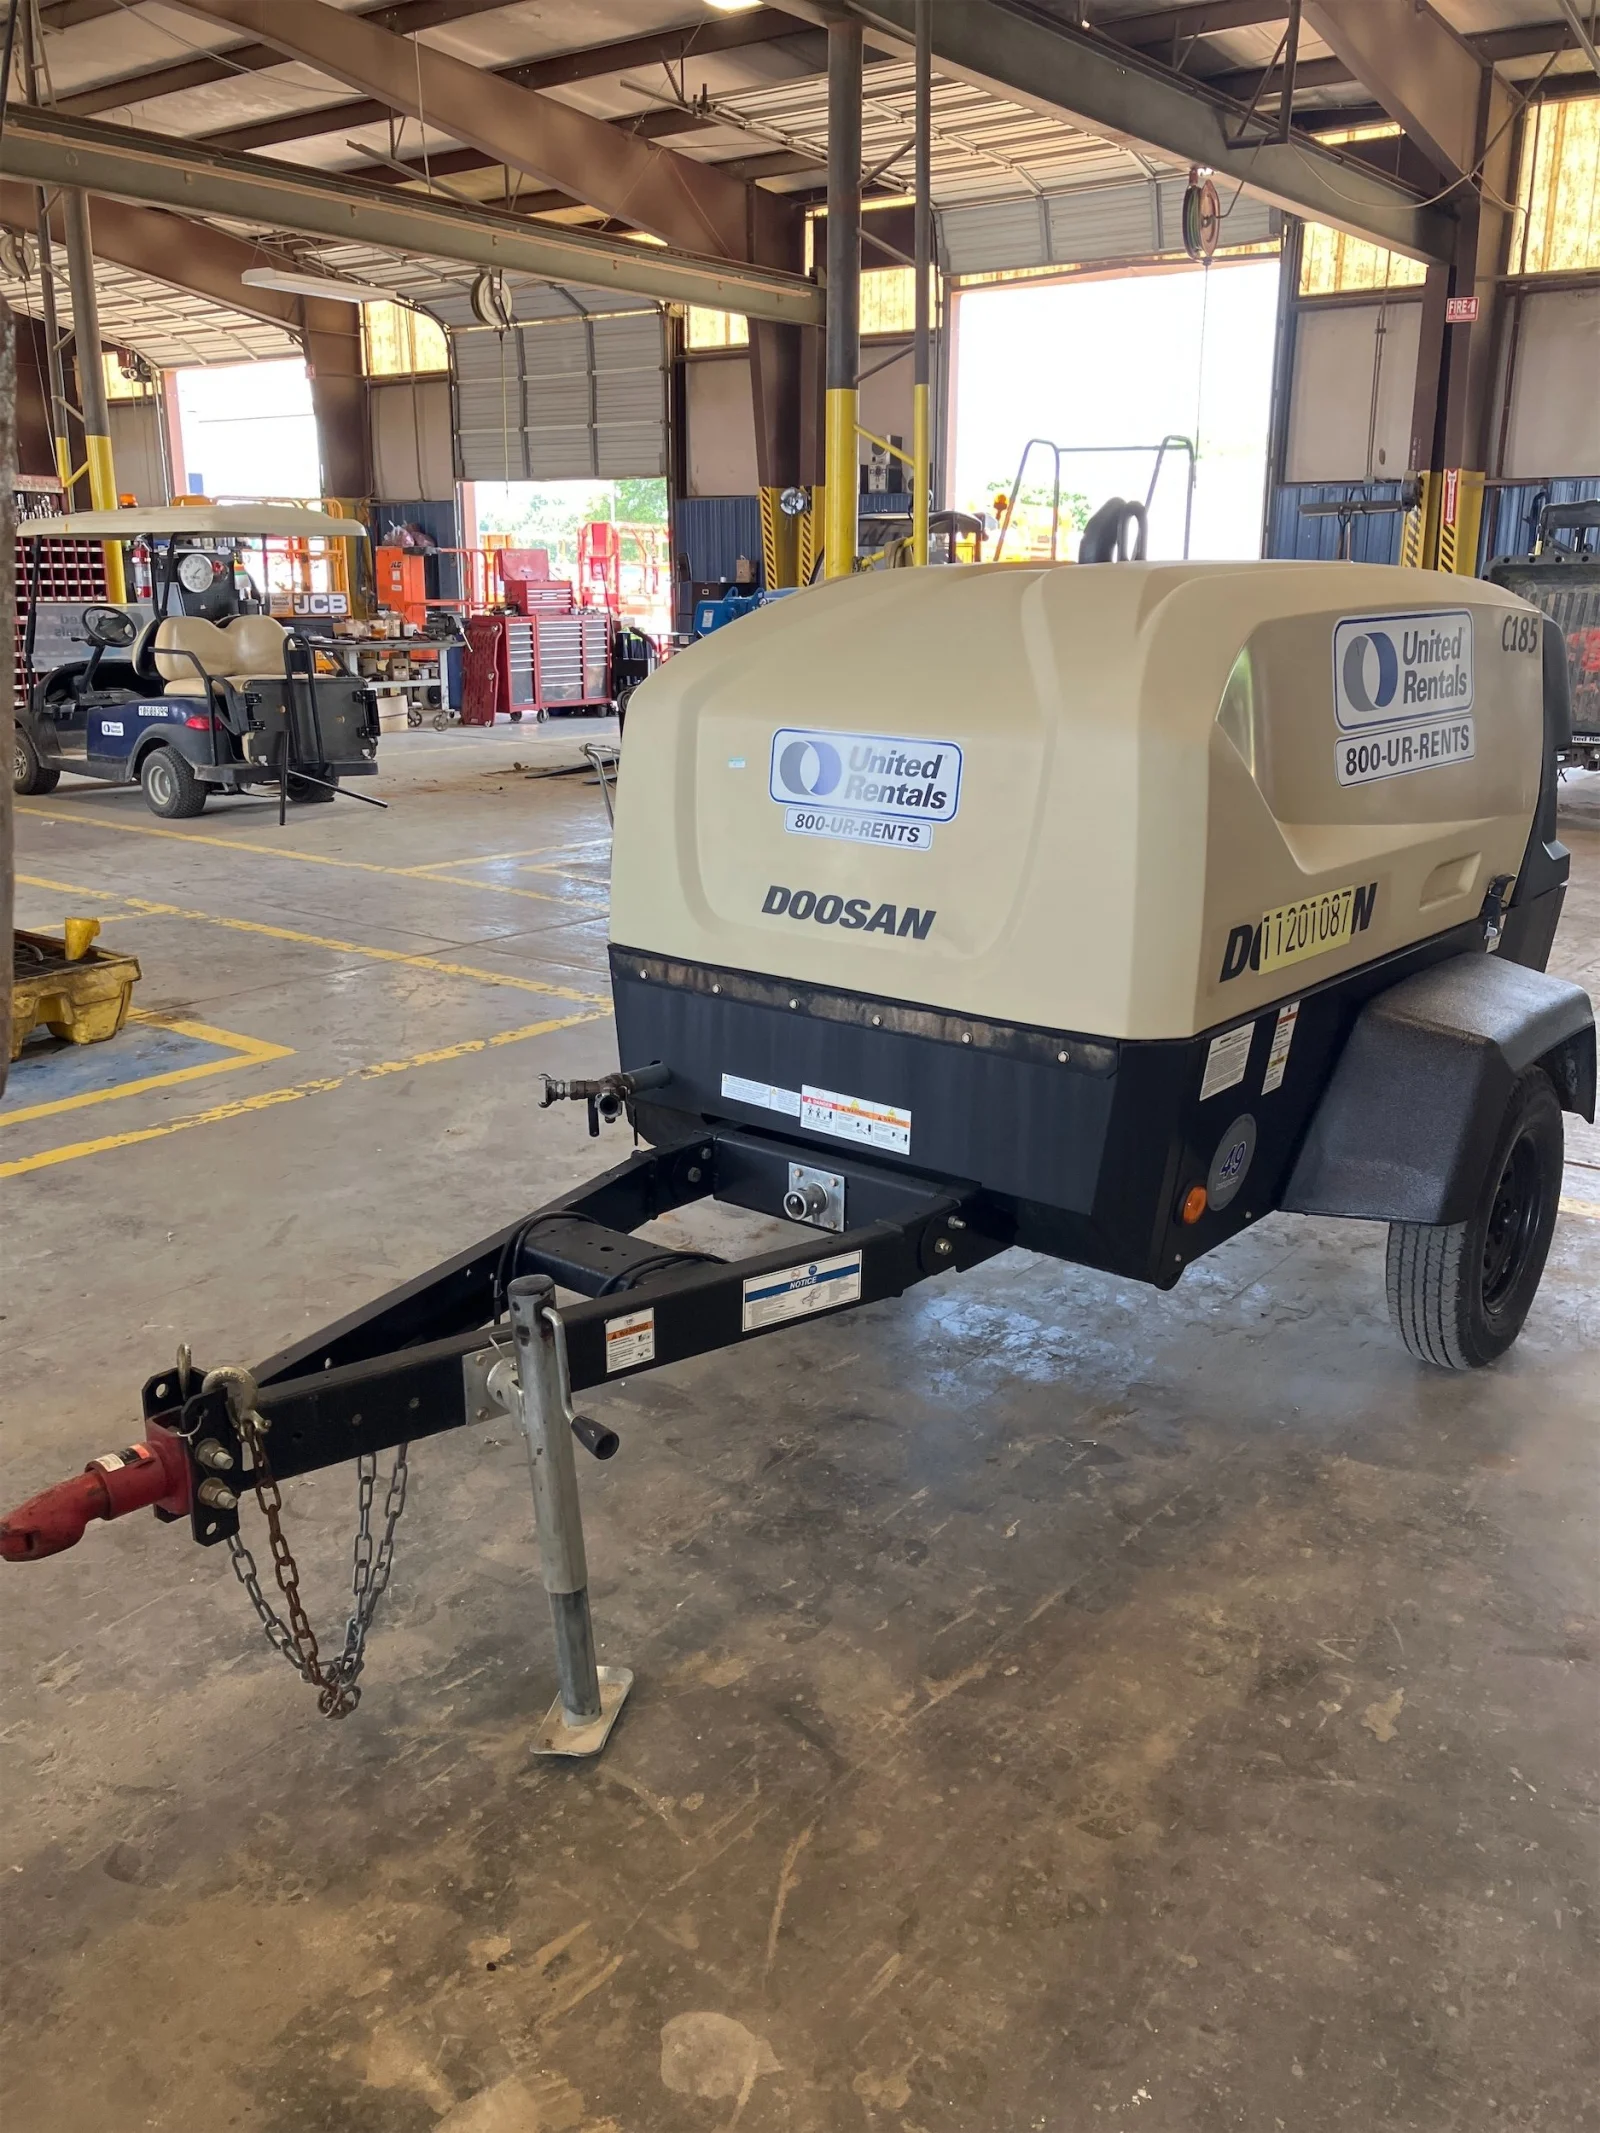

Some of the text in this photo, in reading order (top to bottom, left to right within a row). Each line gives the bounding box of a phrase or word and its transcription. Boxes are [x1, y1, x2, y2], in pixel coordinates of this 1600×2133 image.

[1449, 299, 1468, 315] FIRE
[294, 594, 347, 614] JCB
[1403, 627, 1462, 665] United
[1502, 615, 1538, 653] C185
[1403, 664, 1467, 704] Rentals
[848, 745, 943, 779] United
[1345, 725, 1470, 777] 800-UR-RENTS
[843, 774, 947, 810] Rentals
[794, 813, 921, 843] 800-UR-RENTS
[761, 885, 937, 941] DOOSAN
[1264, 890, 1352, 960] 11201087
[1219, 1141, 1247, 1178] 49
[789, 1276, 817, 1290] NOTICE
